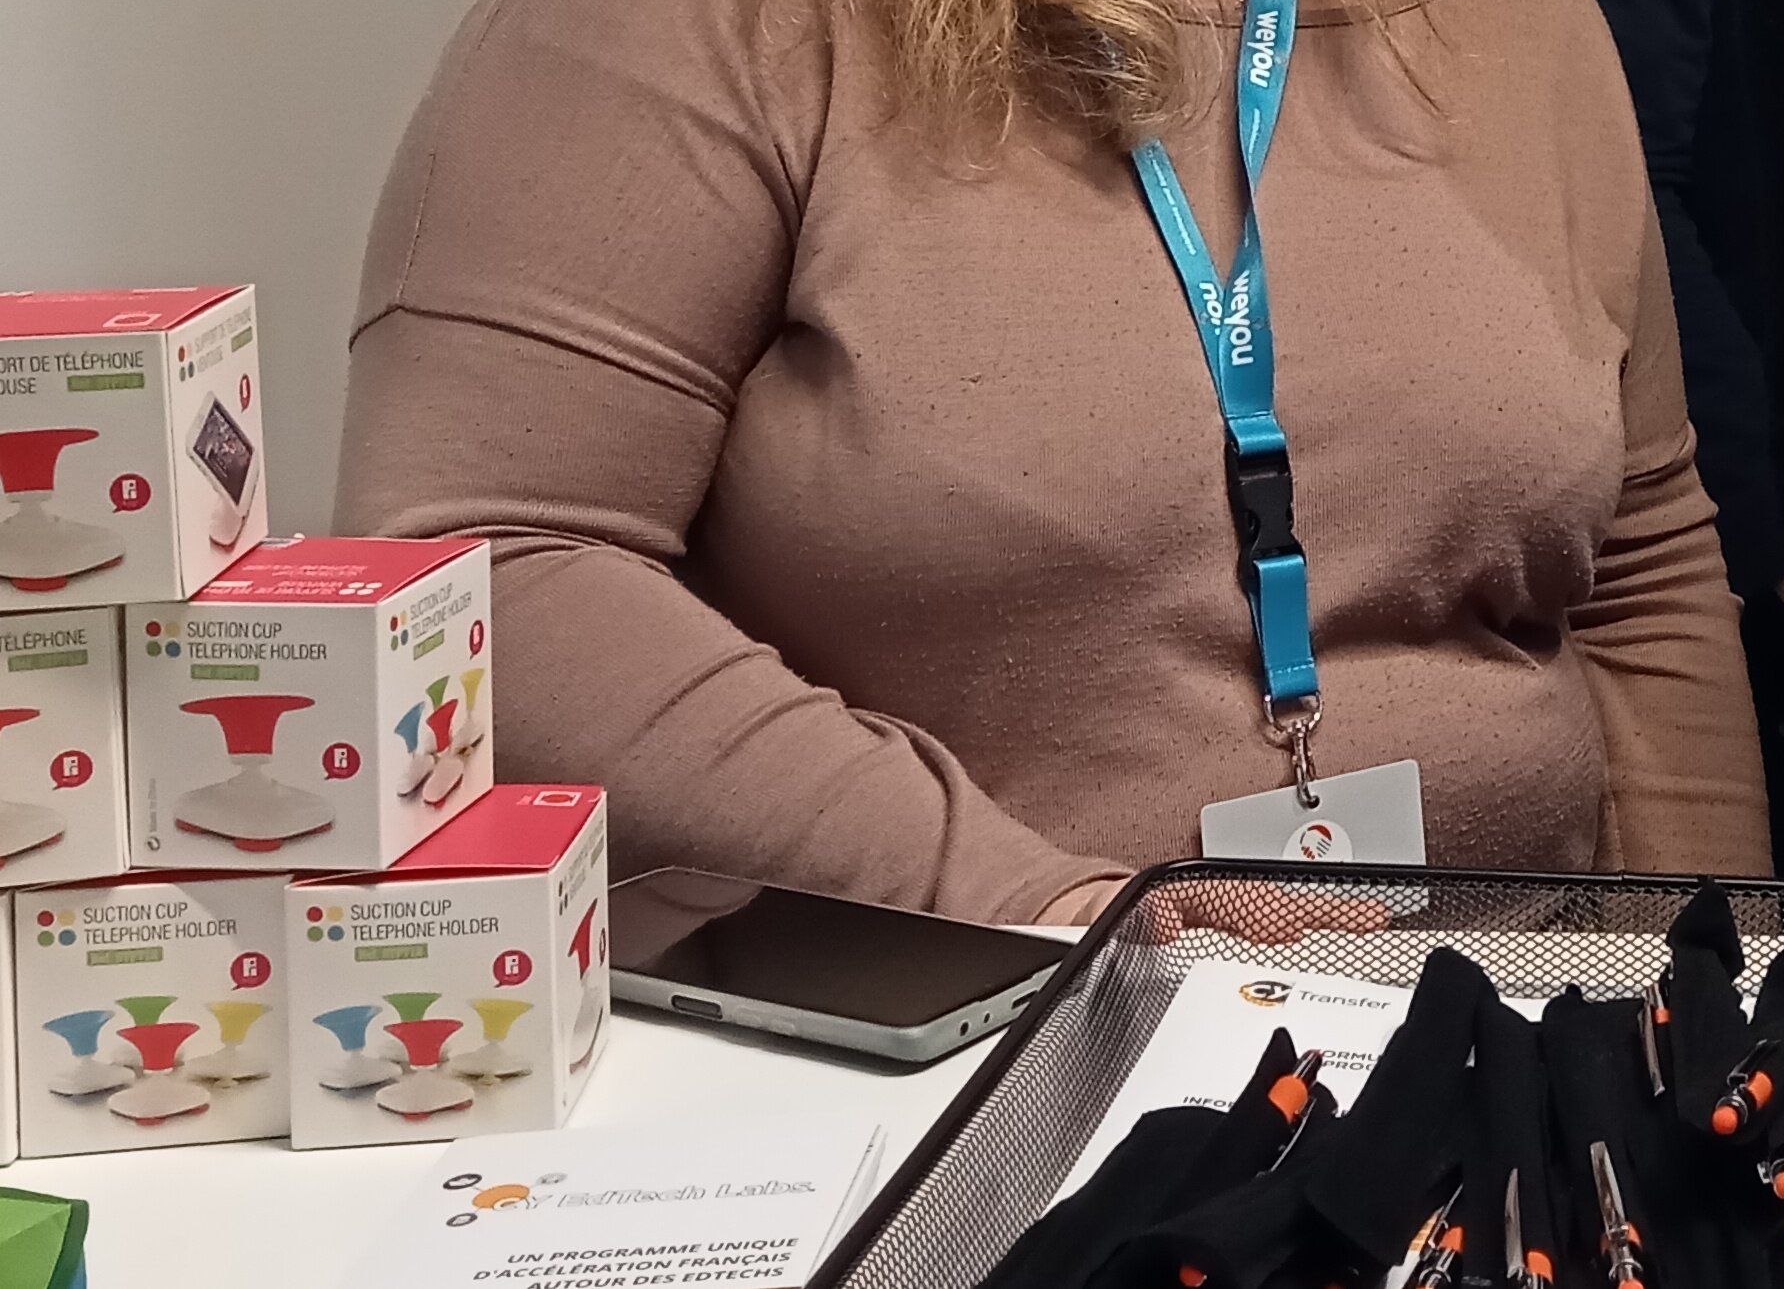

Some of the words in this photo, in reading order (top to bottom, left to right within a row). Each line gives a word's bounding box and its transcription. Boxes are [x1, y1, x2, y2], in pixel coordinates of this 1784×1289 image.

[1247, 11, 1279, 88] weyou
[1223, 270, 1254, 366] weyou
[30, 355, 50, 372] DE
[54, 350, 143, 372] TÉLÉPHONE
[187, 621, 249, 639] SUCTION
[252, 622, 282, 639] CUP
[188, 642, 268, 660] TELEPHONE
[270, 643, 327, 660] HOLDER
[83, 904, 151, 924] SUCTION
[155, 902, 188, 920] CUP
[350, 901, 416, 921] SUCTION
[420, 899, 452, 917] CUP
[84, 924, 172, 945] TELEPHONE
[175, 919, 238, 939] HOLDER
[351, 921, 436, 941] TELEPHONE
[440, 917, 499, 937] HOLDER
[1298, 989, 1392, 1011] Transfer
[508, 1253, 544, 1265] UN
[549, 1243, 702, 1262] PROGRAMME
[707, 1237, 799, 1253] UNIQUE
[679, 1251, 792, 1269] FRANÇAIS
[526, 1276, 628, 1289] AUTOUR
[632, 1273, 677, 1286] DES
[681, 1266, 785, 1283] EDTECHS
